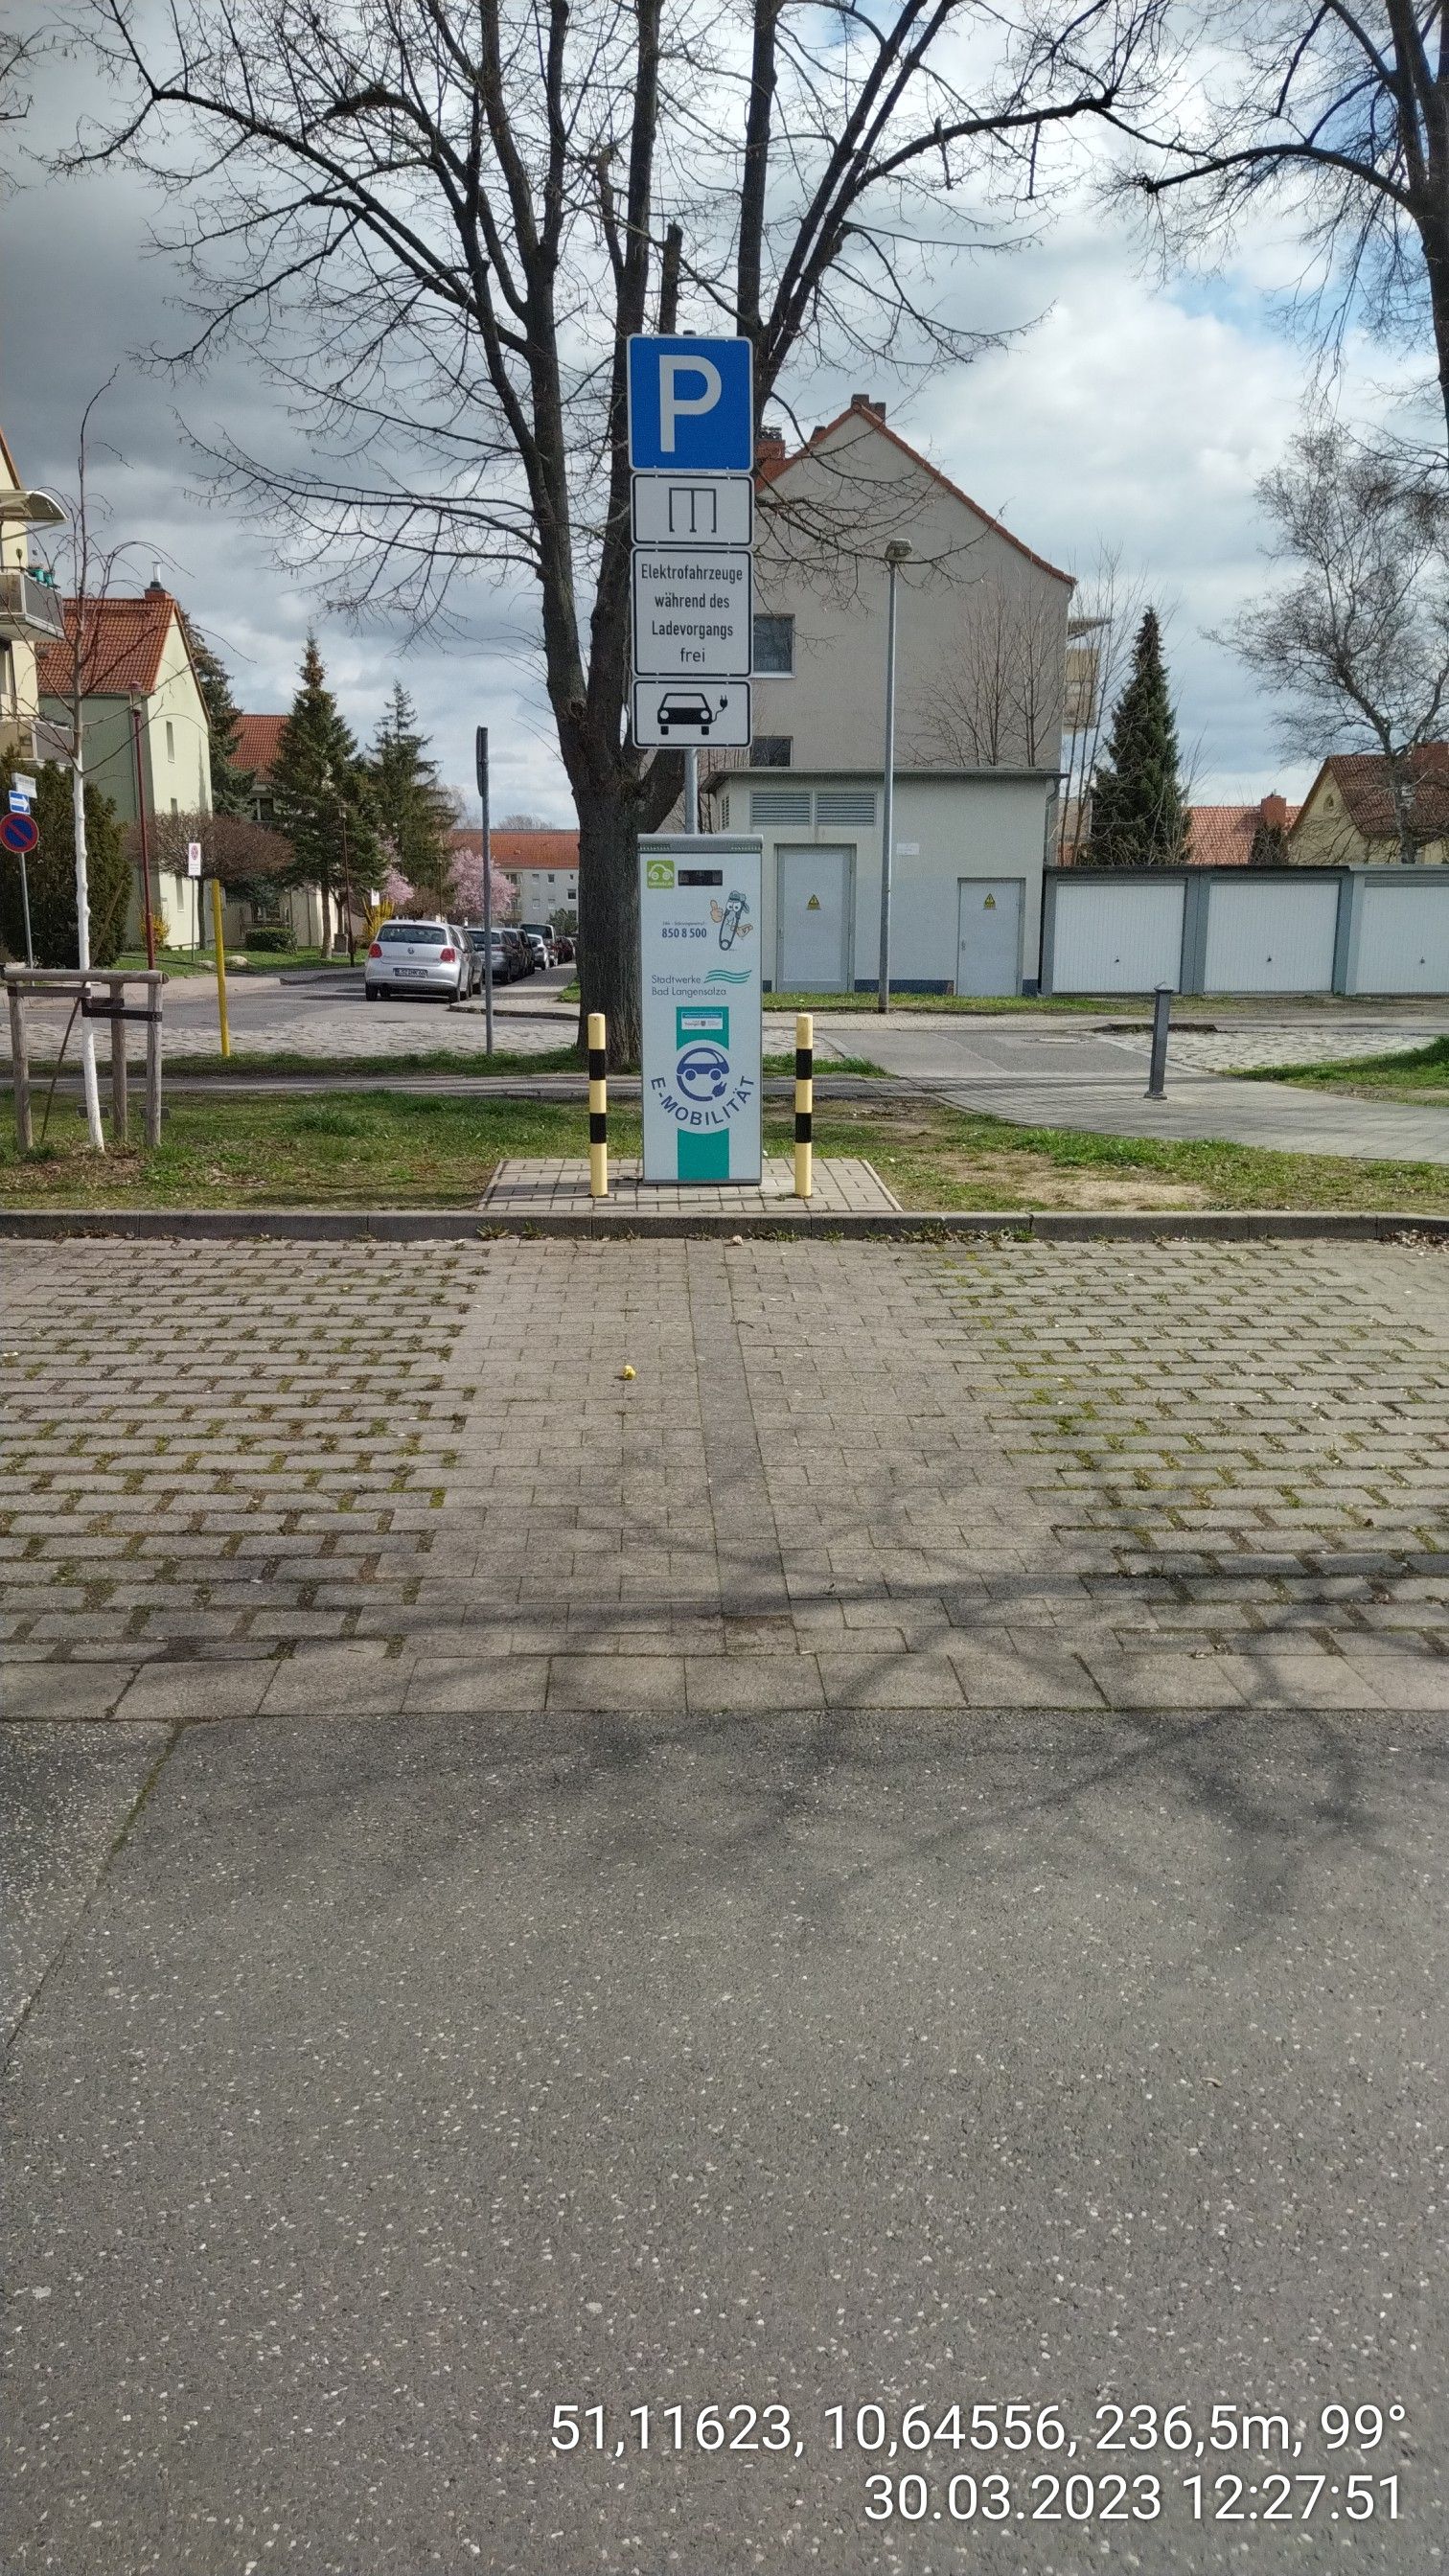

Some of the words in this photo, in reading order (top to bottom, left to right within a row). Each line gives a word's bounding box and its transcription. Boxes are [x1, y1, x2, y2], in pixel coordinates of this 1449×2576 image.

[659, 355, 722, 452] P
[641, 564, 743, 584] Elektrofahrzeuge
[655, 592, 706, 608] während
[709, 593, 730, 608] des
[652, 620, 733, 639] Ladevorgangs
[680, 647, 705, 662] frei
[662, 928, 679, 937] 850
[681, 928, 687, 937] 8
[690, 928, 707, 937] 500
[652, 975, 701, 984] Stadtwerke
[652, 987, 669, 996] Bad
[672, 987, 726, 998] Langensalza
[651, 1075, 754, 1126] E-MOBILITÄT
